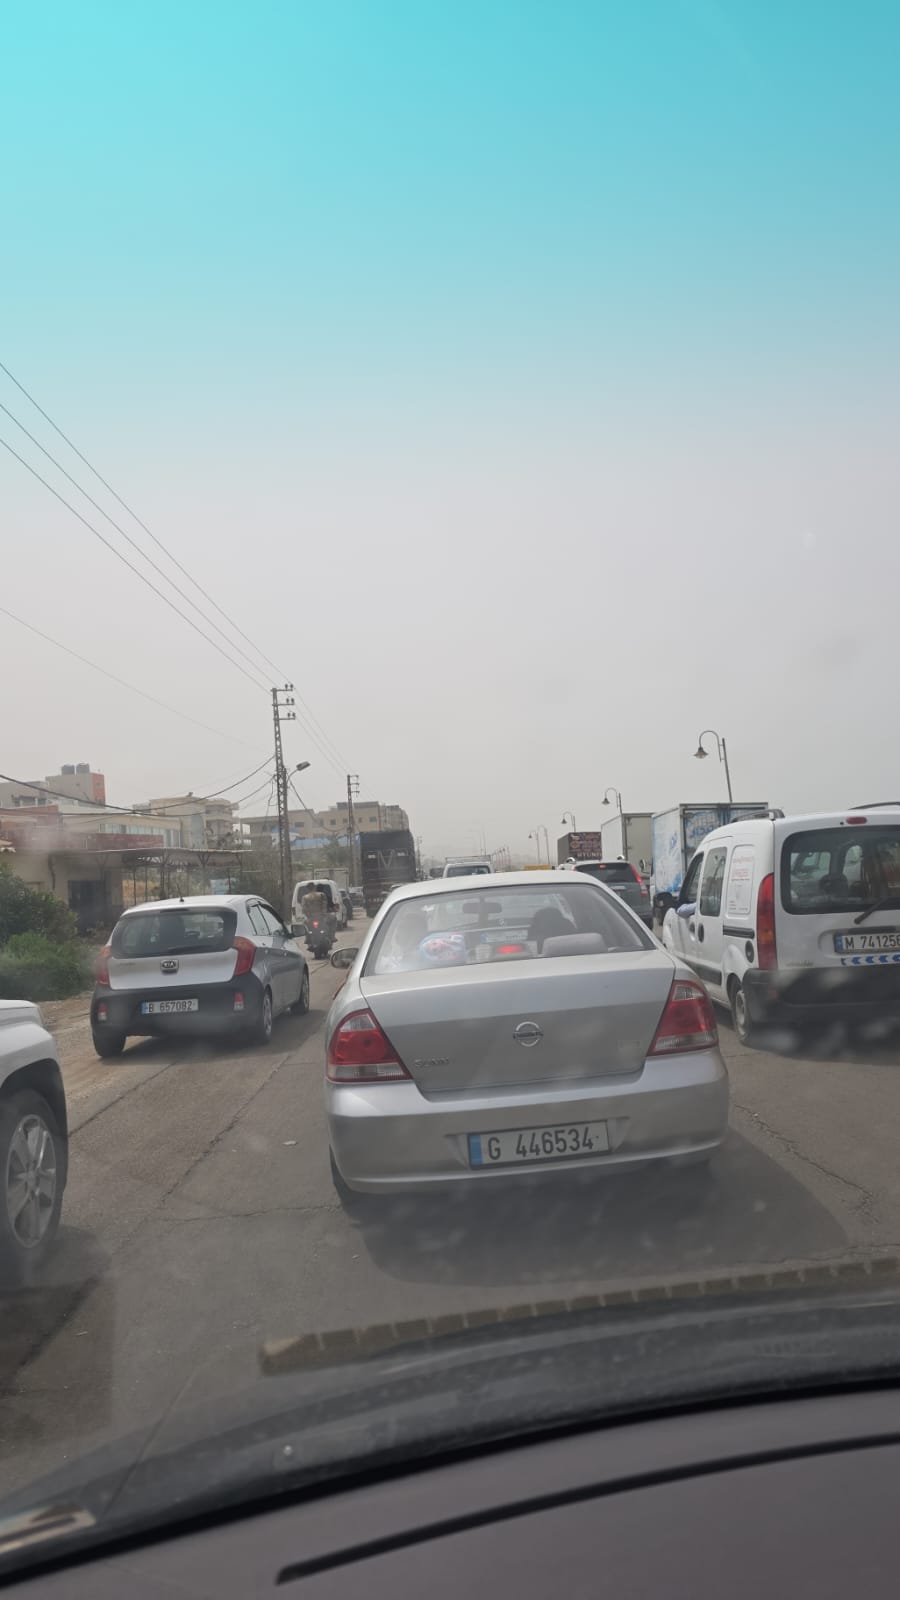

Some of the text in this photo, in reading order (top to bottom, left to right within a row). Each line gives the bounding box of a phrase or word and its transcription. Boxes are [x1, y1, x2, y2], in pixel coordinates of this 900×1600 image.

[845, 936, 855, 949] M
[148, 1003, 154, 1013] B
[487, 1126, 594, 1160] G 446534
